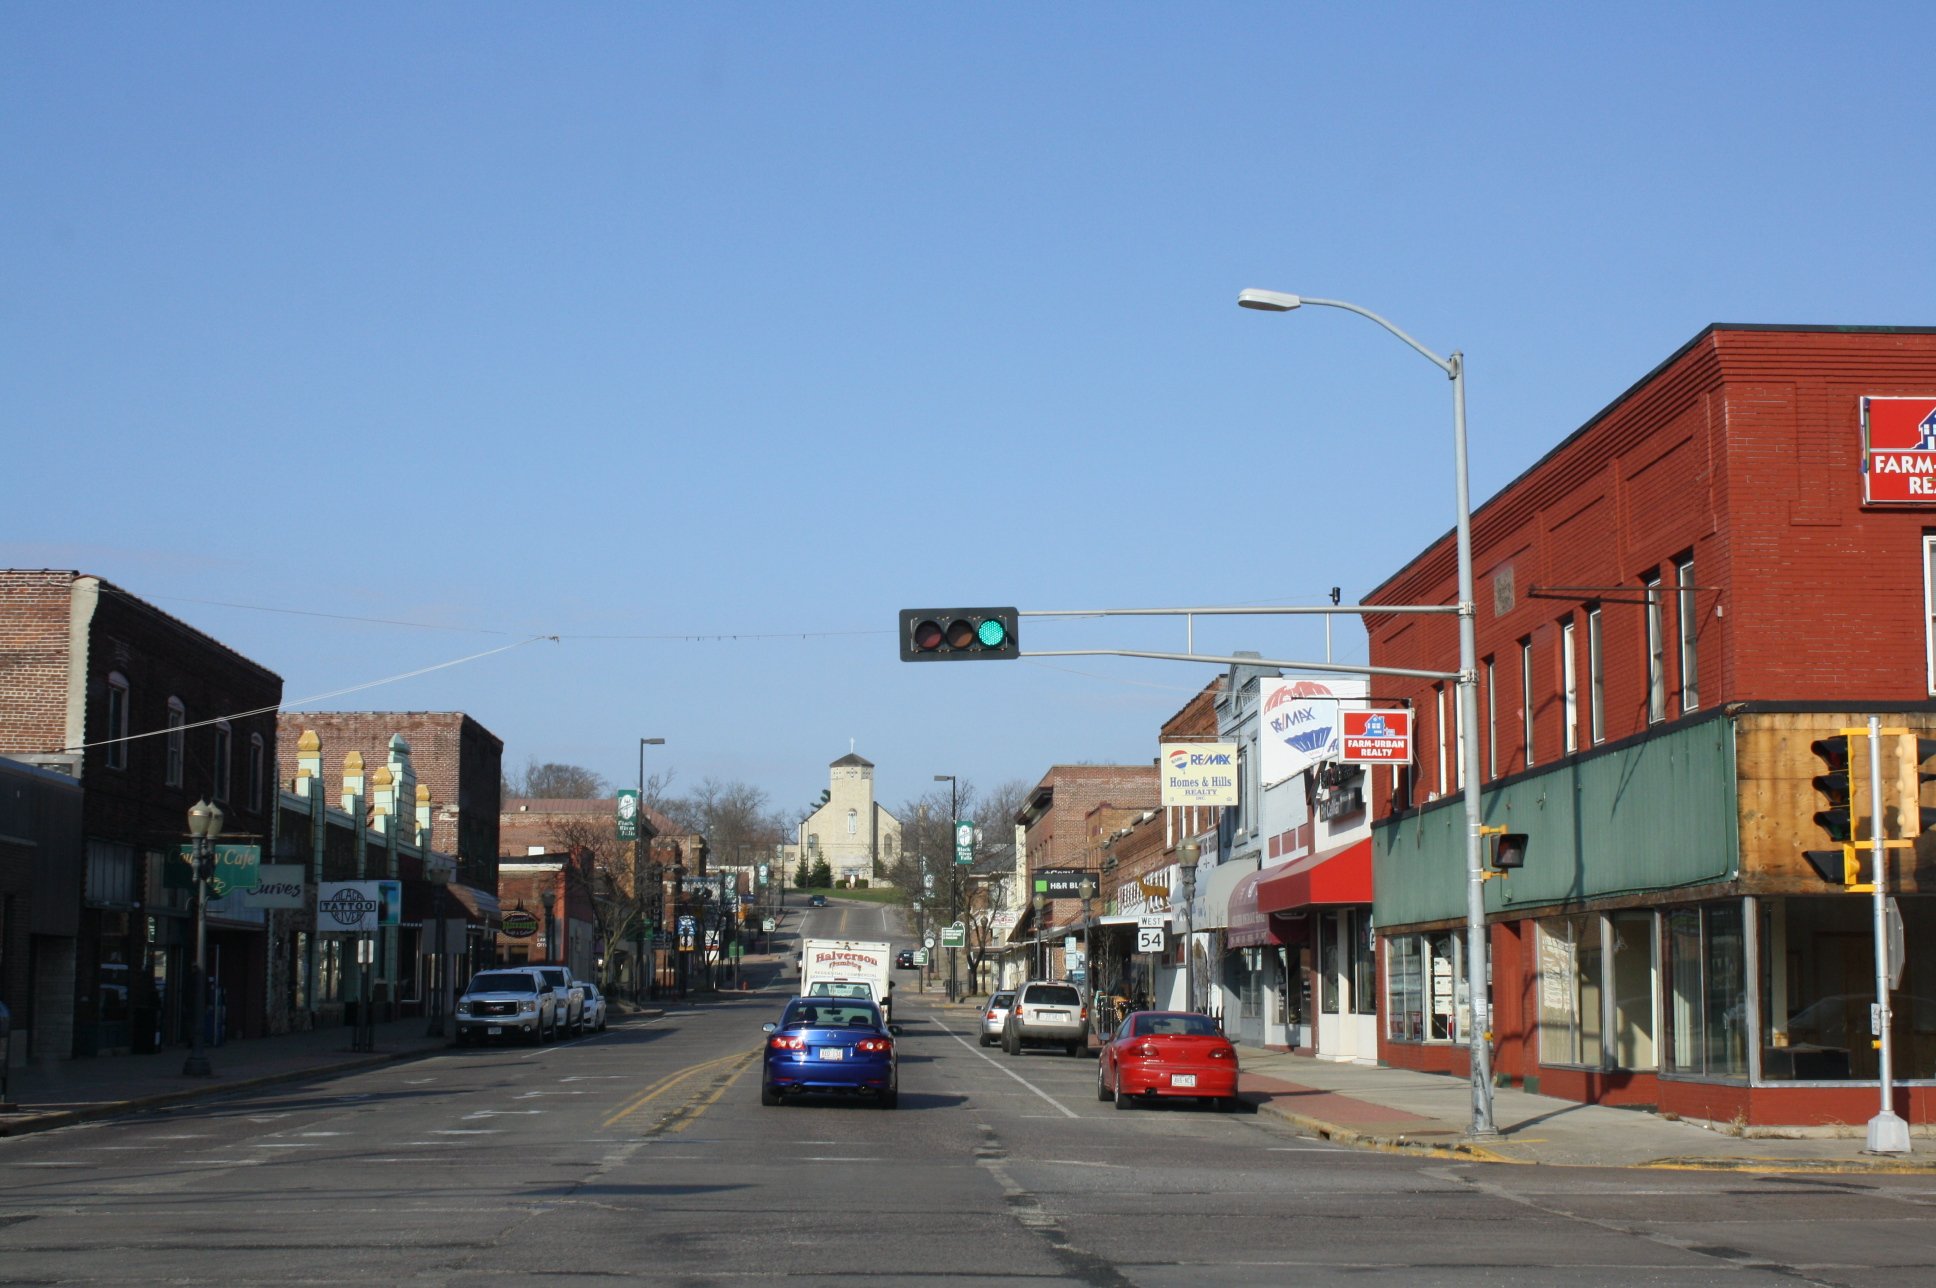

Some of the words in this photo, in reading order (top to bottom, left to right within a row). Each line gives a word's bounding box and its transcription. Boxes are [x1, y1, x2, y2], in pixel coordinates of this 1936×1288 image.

[1909, 476, 1936, 494] RE
[1270, 707, 1316, 733] RE/MAX
[1347, 740, 1404, 749] FARM-URBAN
[1361, 748, 1393, 757] REALTY
[1190, 754, 1231, 765] RE/MAX
[1170, 776, 1199, 787] Homes
[1201, 776, 1209, 787] &
[1211, 775, 1232, 787] Hills
[224, 848, 256, 869] Cafe
[246, 877, 302, 897] Curves
[1050, 881, 1067, 890] H&R
[1069, 881, 1097, 890] BLK
[323, 902, 373, 911] TATTOO
[334, 911, 361, 923] RIVER
[1141, 917, 1161, 926] WEST
[1141, 933, 1162, 948] 54
[816, 951, 878, 966] Halverson
